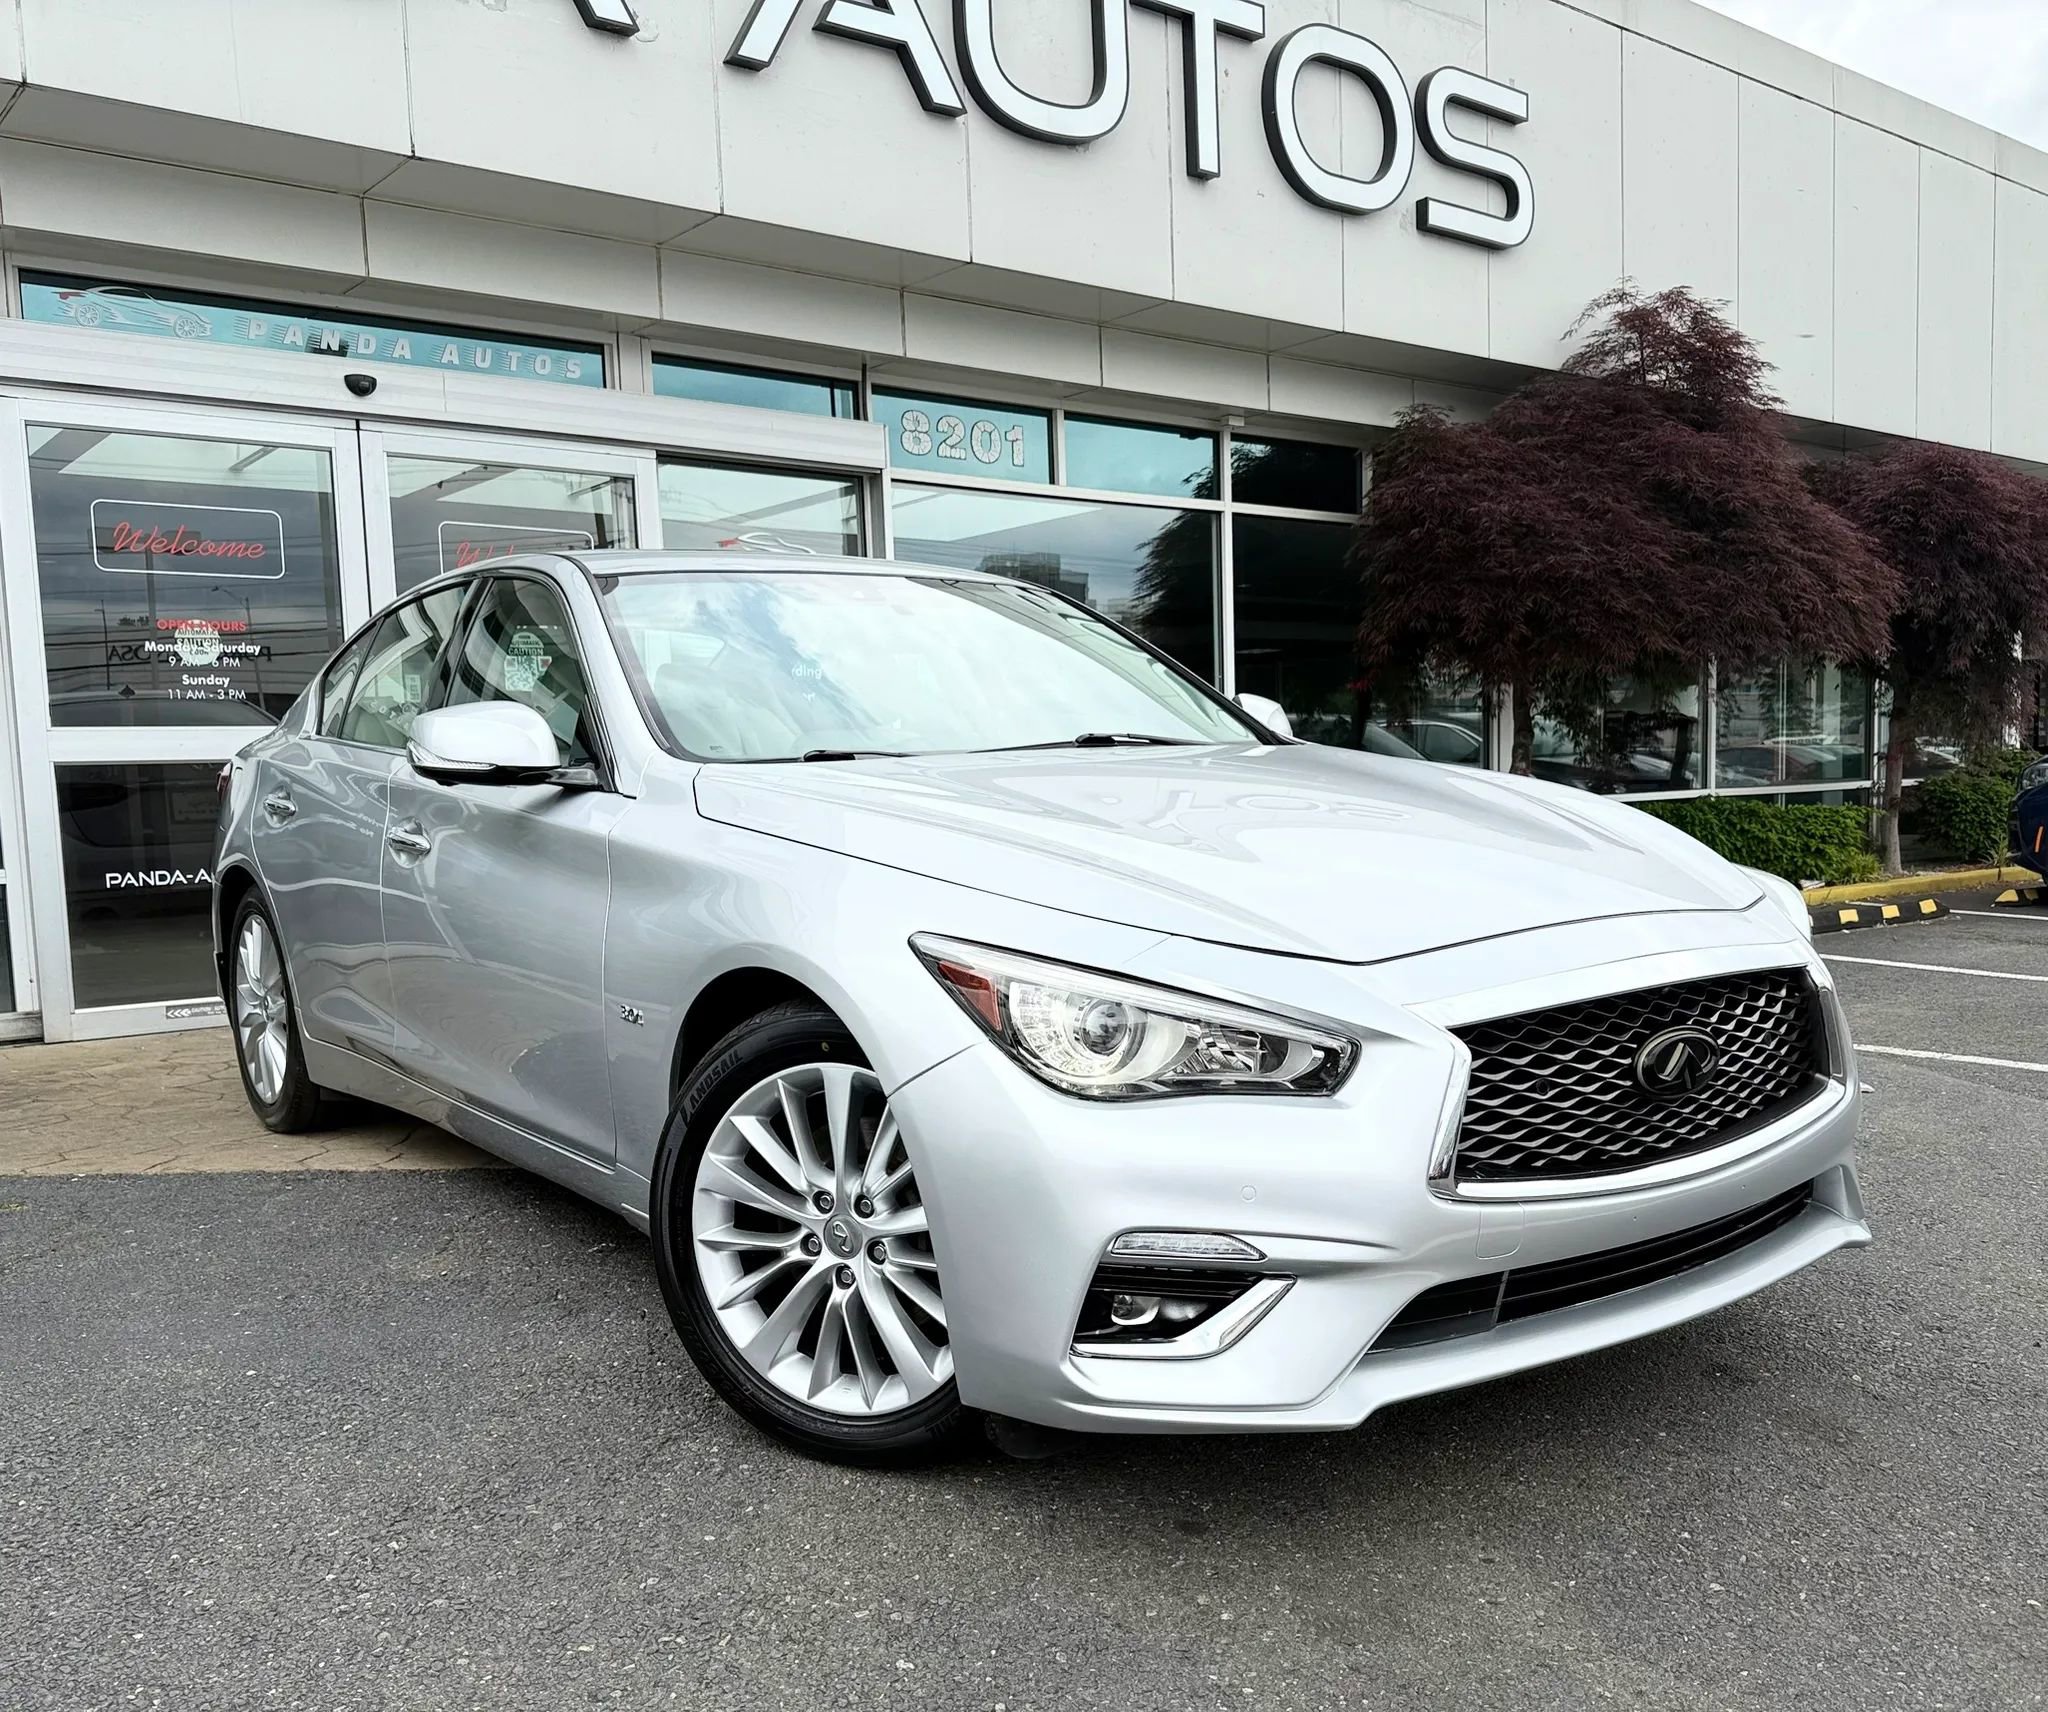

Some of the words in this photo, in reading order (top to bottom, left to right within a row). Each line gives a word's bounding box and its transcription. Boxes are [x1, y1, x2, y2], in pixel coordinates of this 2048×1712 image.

[725, 0, 1533, 250] AUTOS
[247, 318, 413, 360] PANDA
[440, 343, 582, 380] AUTOS
[900, 409, 1024, 468] 8201
[112, 521, 266, 560] Welcome
[156, 619, 192, 631] OPEN
[202, 619, 248, 632] HOURS
[168, 656, 177, 667] 9
[180, 656, 200, 667] AM
[211, 656, 220, 668] 6
[223, 657, 241, 668] PM
[182, 674, 230, 688] Sunday
[168, 689, 181, 699] 11
[186, 689, 206, 699] AM
[217, 689, 225, 699] 3
[229, 690, 246, 700] PM
